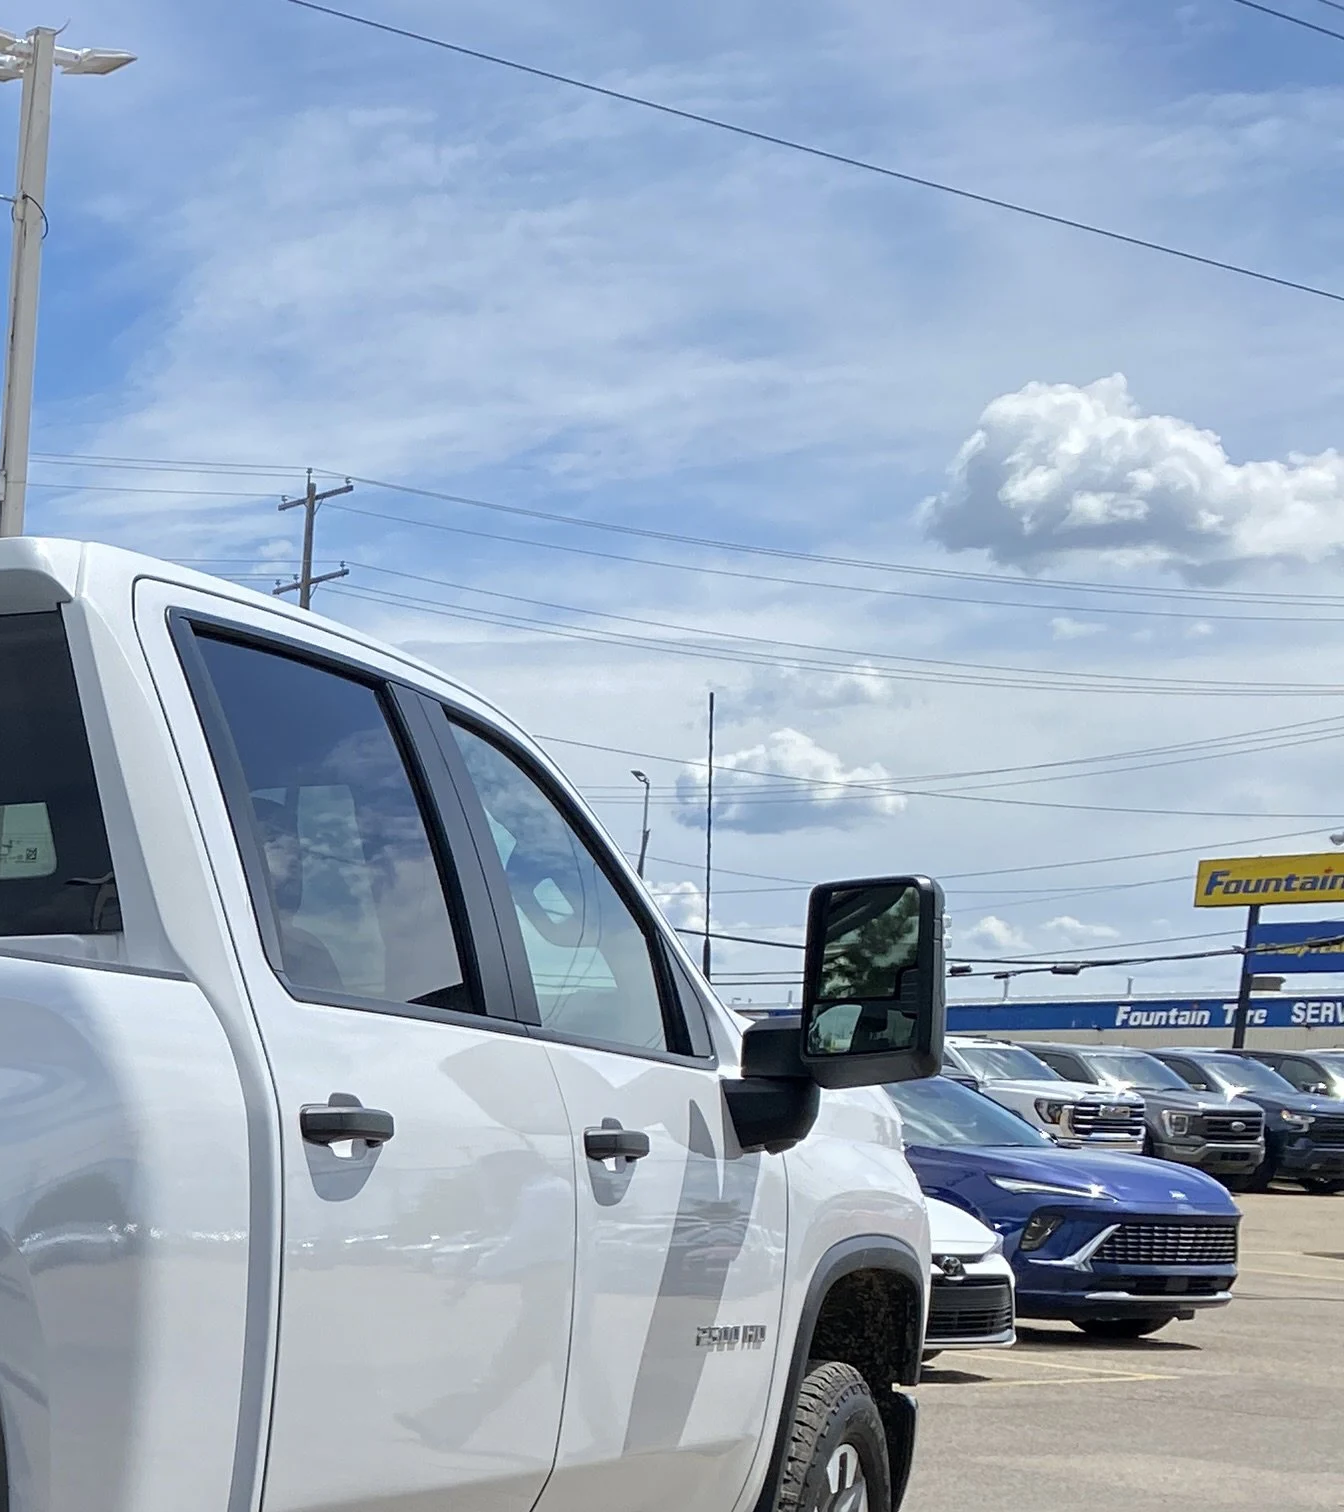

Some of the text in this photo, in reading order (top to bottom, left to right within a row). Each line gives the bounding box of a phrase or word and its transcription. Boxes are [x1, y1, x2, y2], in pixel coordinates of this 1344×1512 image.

[1204, 867, 1344, 896] Fountain
[1115, 1004, 1211, 1026] Fountain
[1222, 1003, 1268, 1025] Tre
